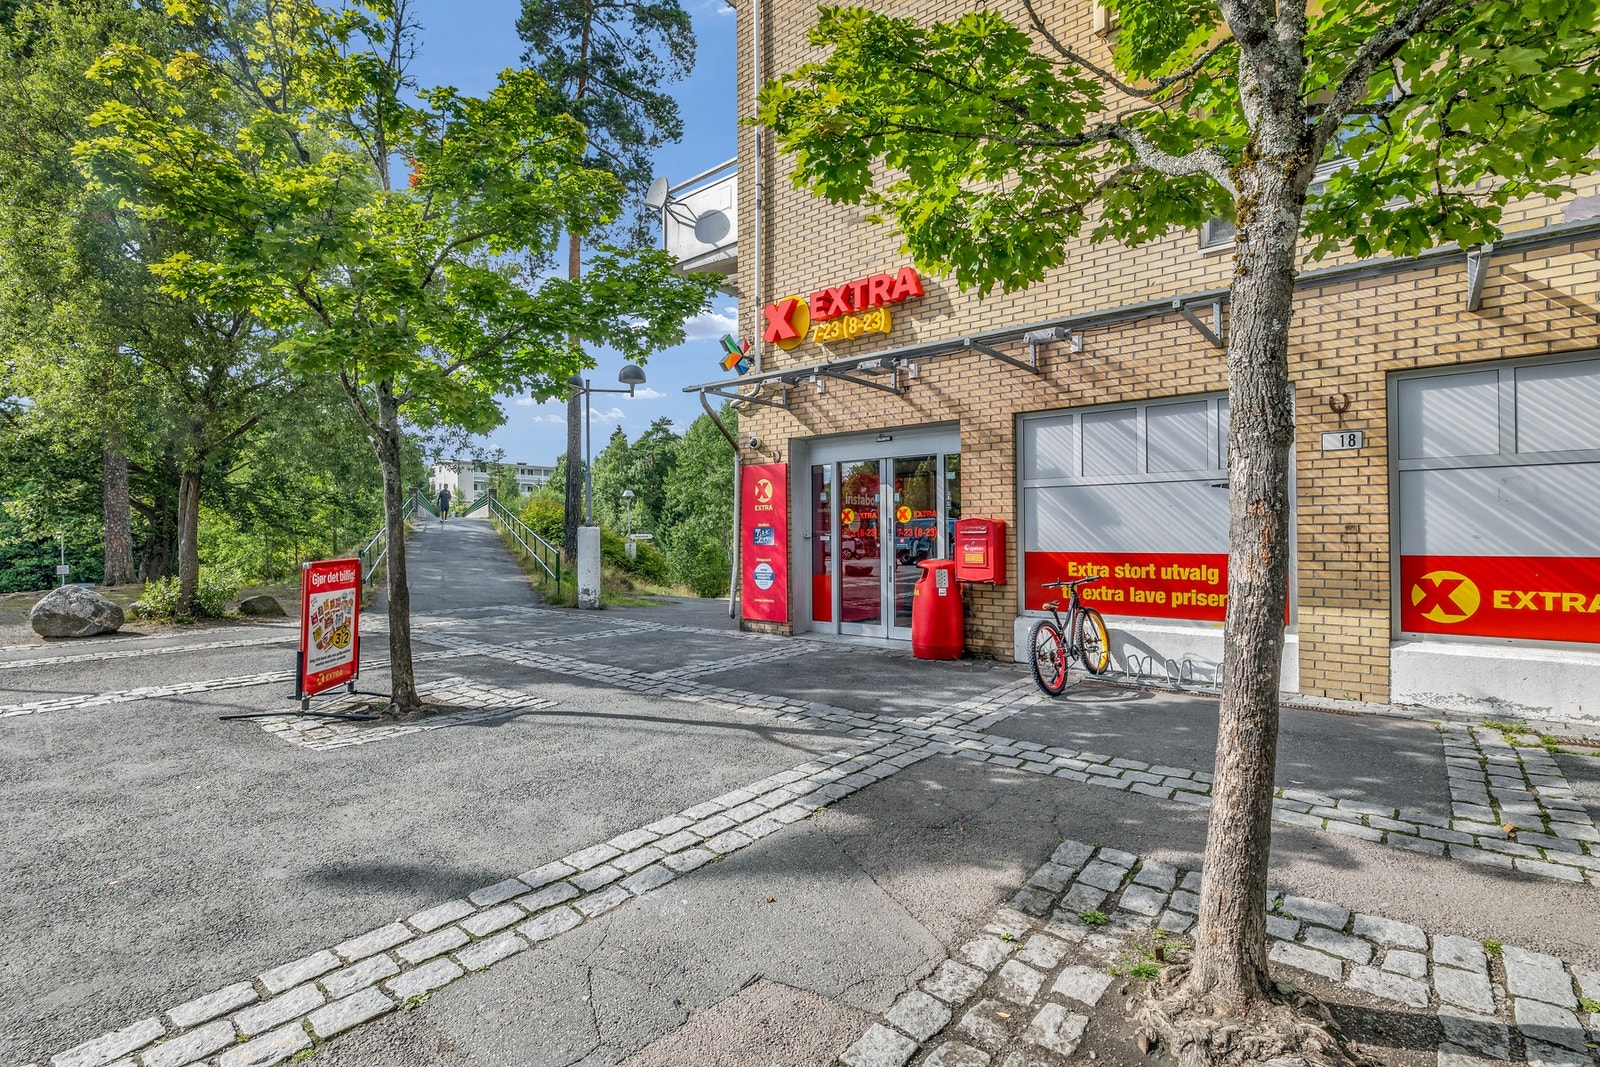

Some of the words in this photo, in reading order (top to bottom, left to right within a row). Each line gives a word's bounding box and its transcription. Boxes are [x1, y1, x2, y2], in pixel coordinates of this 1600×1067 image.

[809, 266, 925, 322] EXTRA
[812, 320, 840, 345] 7-23
[843, 308, 892, 341] (8-23)
[1339, 433, 1356, 448] 18
[845, 492, 877, 507] instabo
[913, 510, 938, 518] EXTRA
[897, 527, 913, 538] 7-23
[914, 526, 938, 539] (8-23)
[312, 572, 327, 587] Gjør
[327, 571, 339, 583] det
[339, 569, 356, 583] billig!
[1067, 561, 1110, 578] Extra
[1114, 563, 1156, 580] stort
[1160, 564, 1220, 585] utvalg
[1061, 585, 1078, 600] ti
[1082, 587, 1124, 602] extra
[1129, 587, 1166, 604] lave
[1171, 589, 1228, 608] priser
